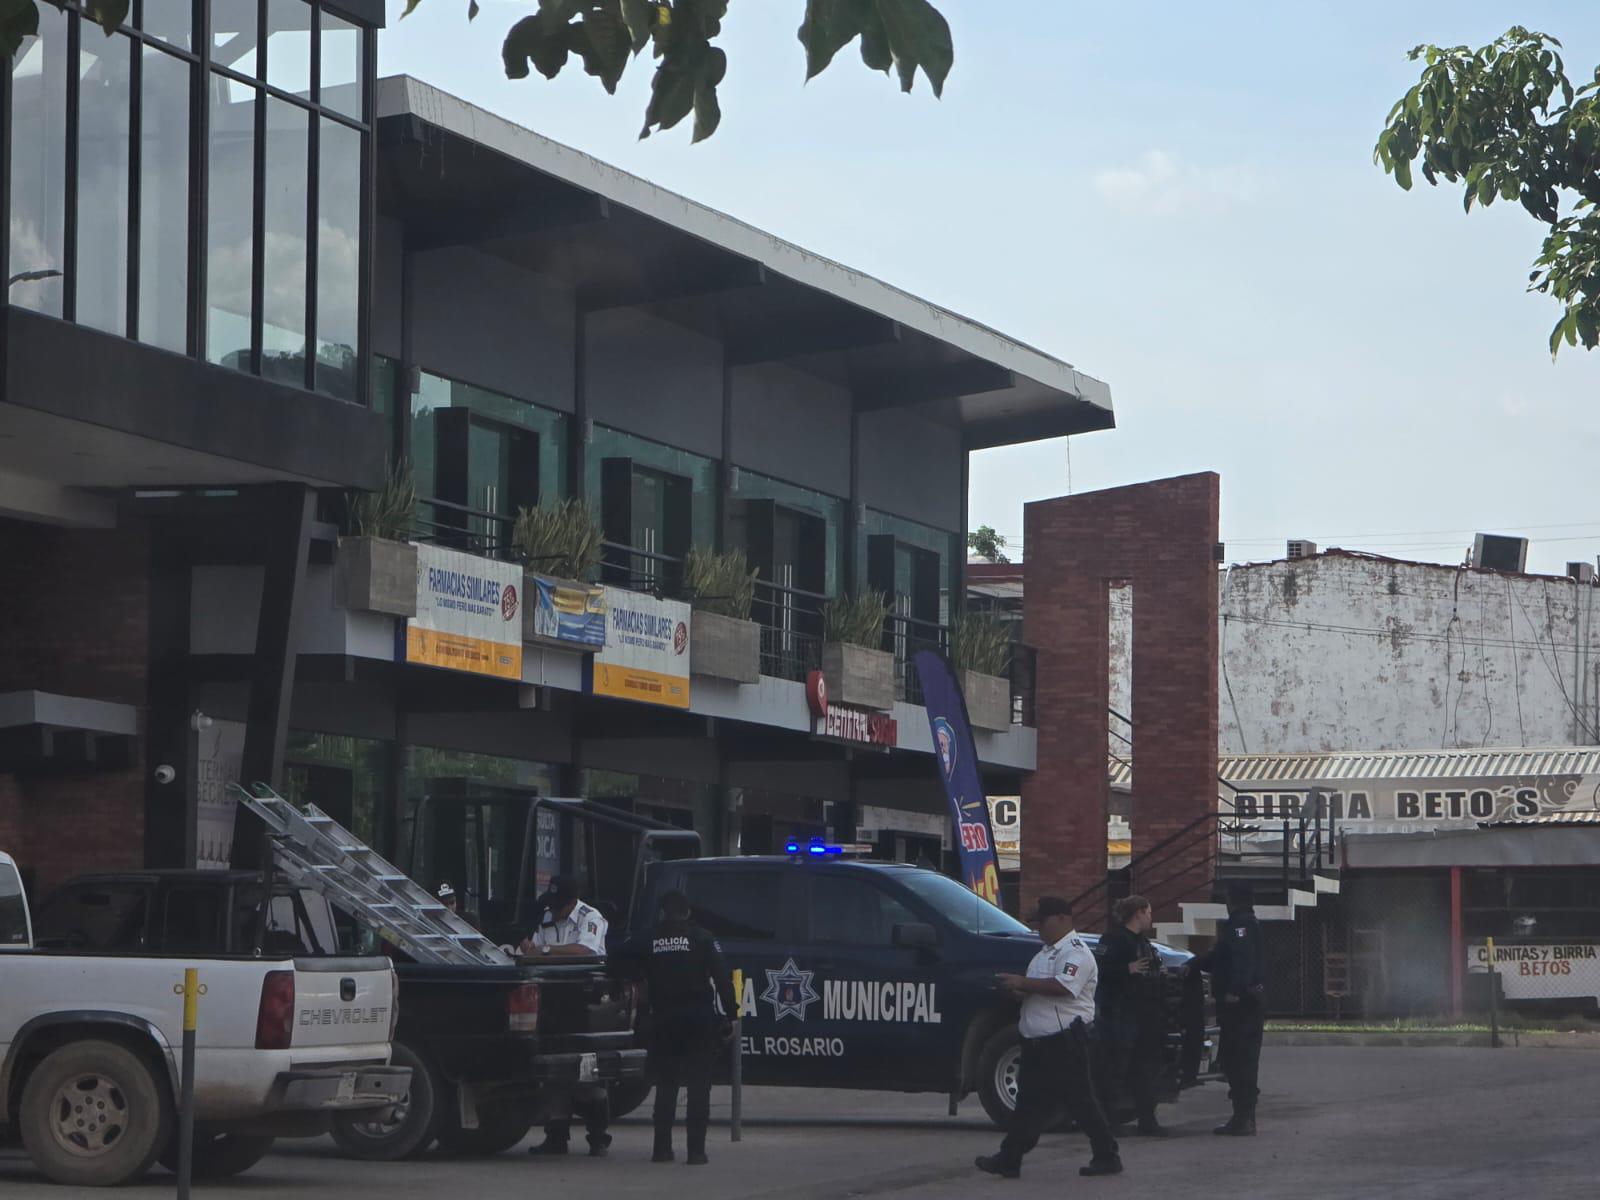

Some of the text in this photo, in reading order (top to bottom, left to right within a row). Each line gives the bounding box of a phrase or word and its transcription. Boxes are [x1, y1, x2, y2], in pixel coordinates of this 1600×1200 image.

[428, 567, 501, 606] FARMACIAS SIMILARES
[612, 607, 643, 635] FARMACIAS
[644, 613, 673, 641] SIMILARES
[827, 704, 871, 743] CENTRAL
[653, 936, 690, 946] POLICÍA
[1553, 946, 1597, 961] BIRRIA
[823, 980, 942, 1023] MUNICIPAL
[299, 1007, 388, 1026] CHEVROLET
[764, 1037, 844, 1056] ROSARIO
